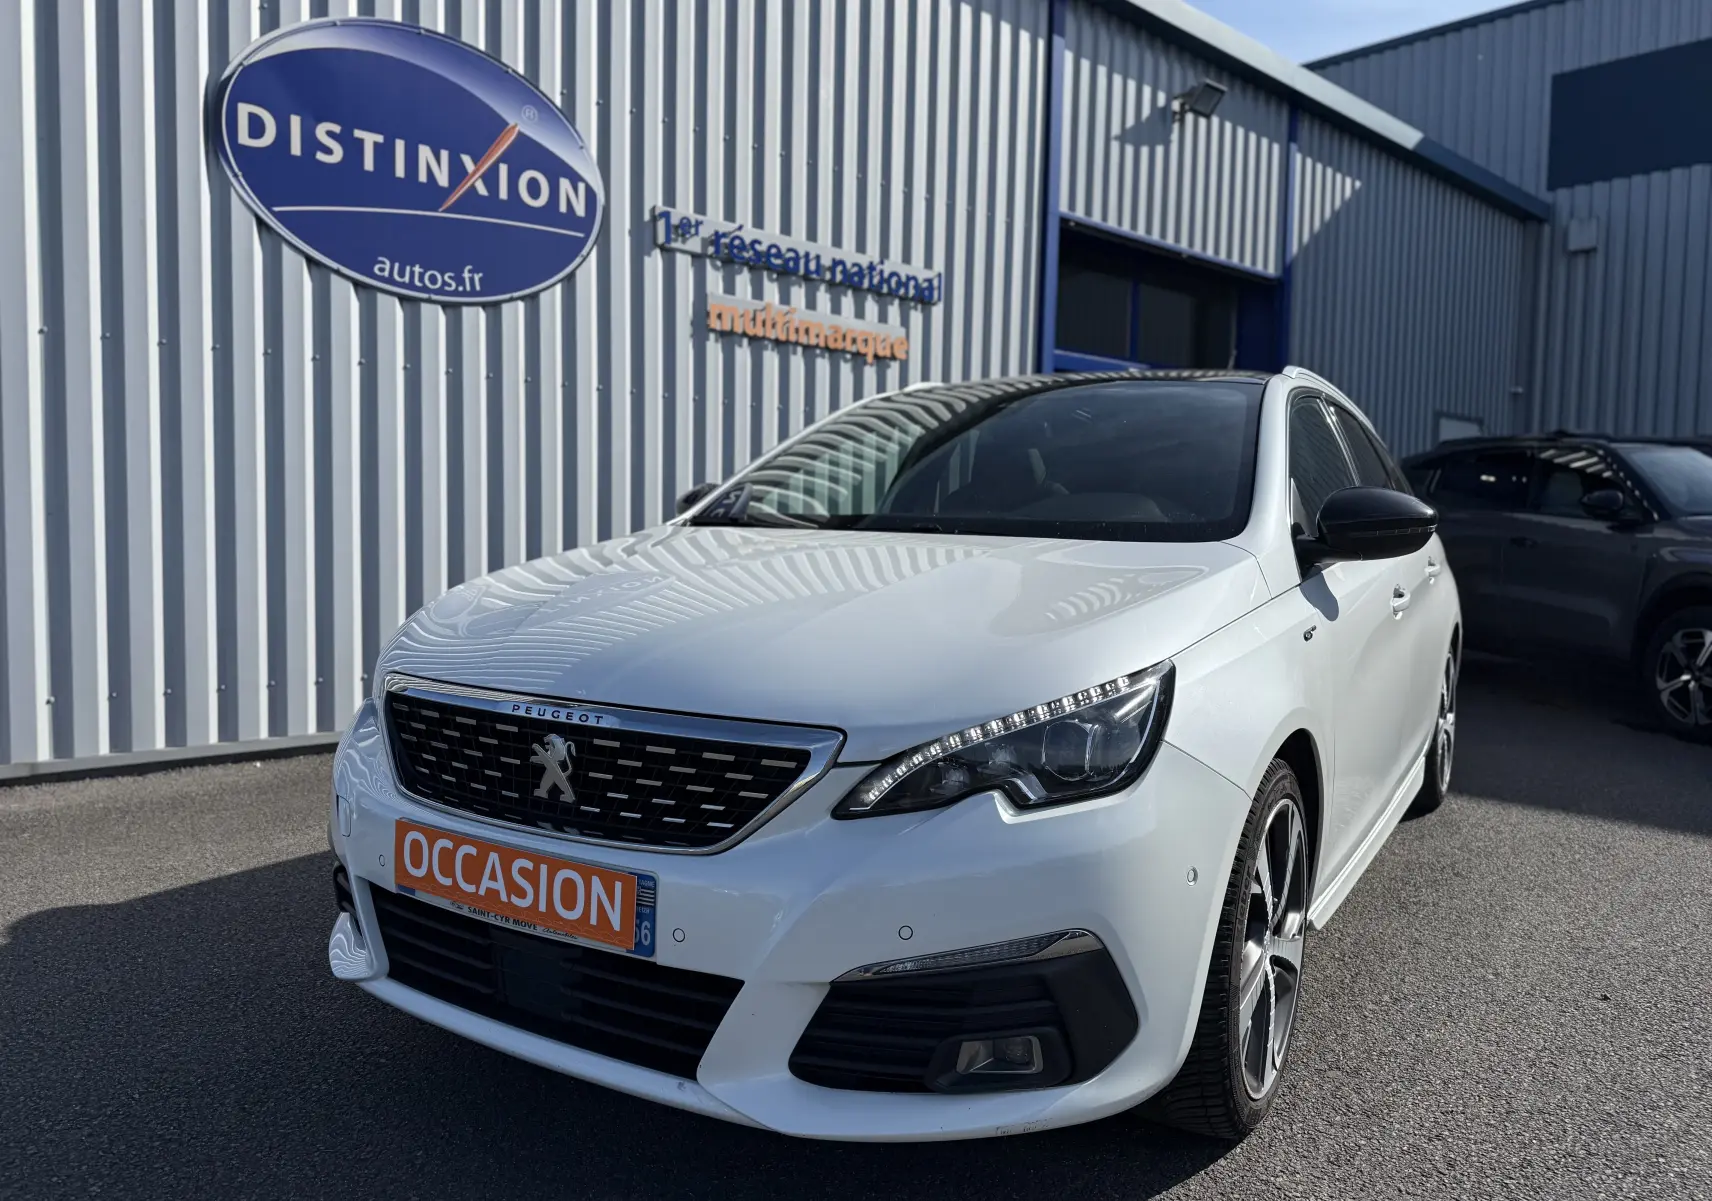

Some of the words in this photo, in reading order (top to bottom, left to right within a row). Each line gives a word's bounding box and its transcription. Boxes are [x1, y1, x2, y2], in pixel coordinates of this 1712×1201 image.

[237, 102, 587, 217] DISTINXION
[373, 257, 484, 292] autos.fr
[657, 209, 703, 245] 1er
[714, 225, 821, 277] réseau
[831, 257, 943, 303] national
[708, 302, 908, 364] multimarque
[511, 703, 604, 724] PEUGEOT
[403, 831, 622, 932] OCCASION
[467, 906, 511, 924] SAINT-CYR
[512, 919, 538, 931] MOVE
